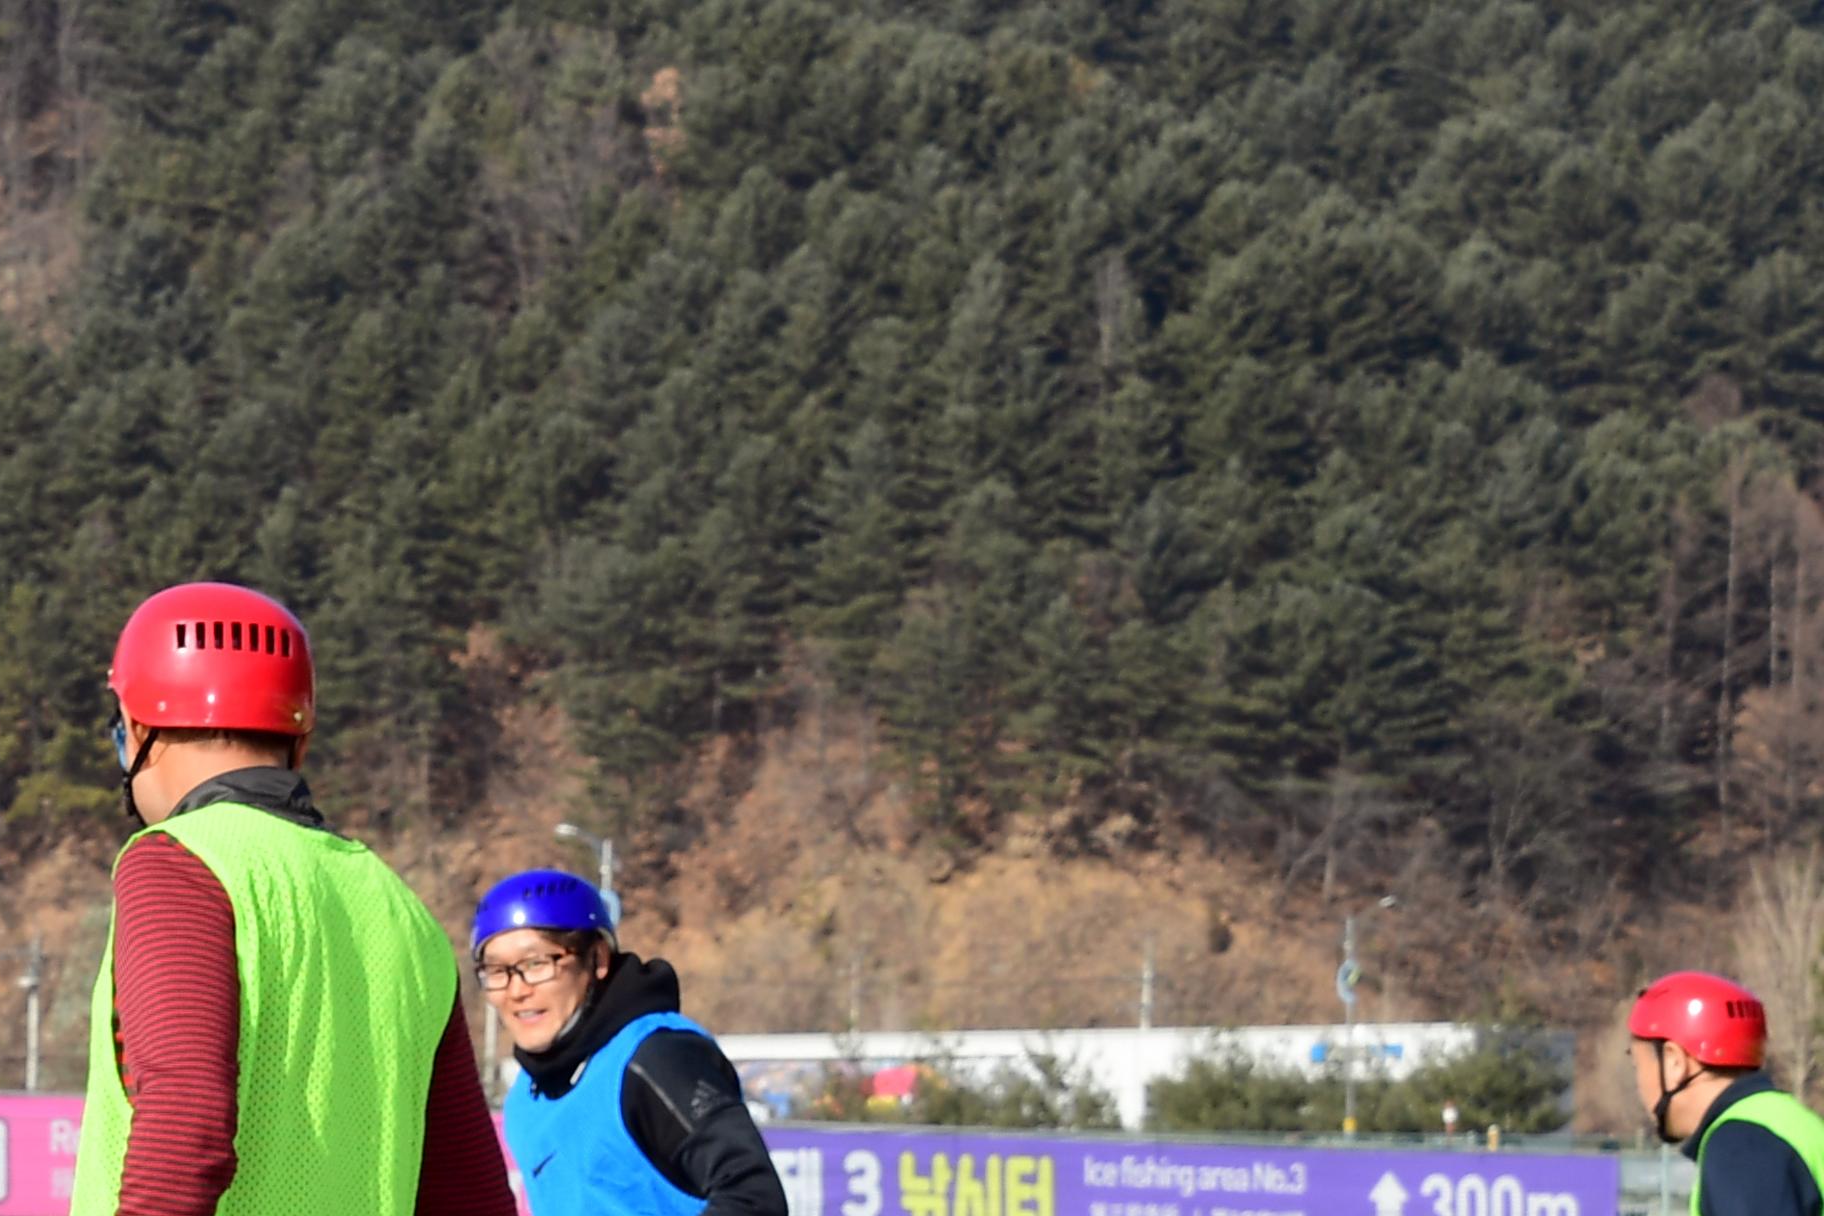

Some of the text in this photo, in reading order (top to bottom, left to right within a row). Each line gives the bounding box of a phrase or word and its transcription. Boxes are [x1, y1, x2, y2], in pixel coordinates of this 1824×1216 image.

[1083, 1155, 1118, 1188] Ice
[1121, 1155, 1195, 1198] fishing
[1198, 1166, 1250, 1192] area
